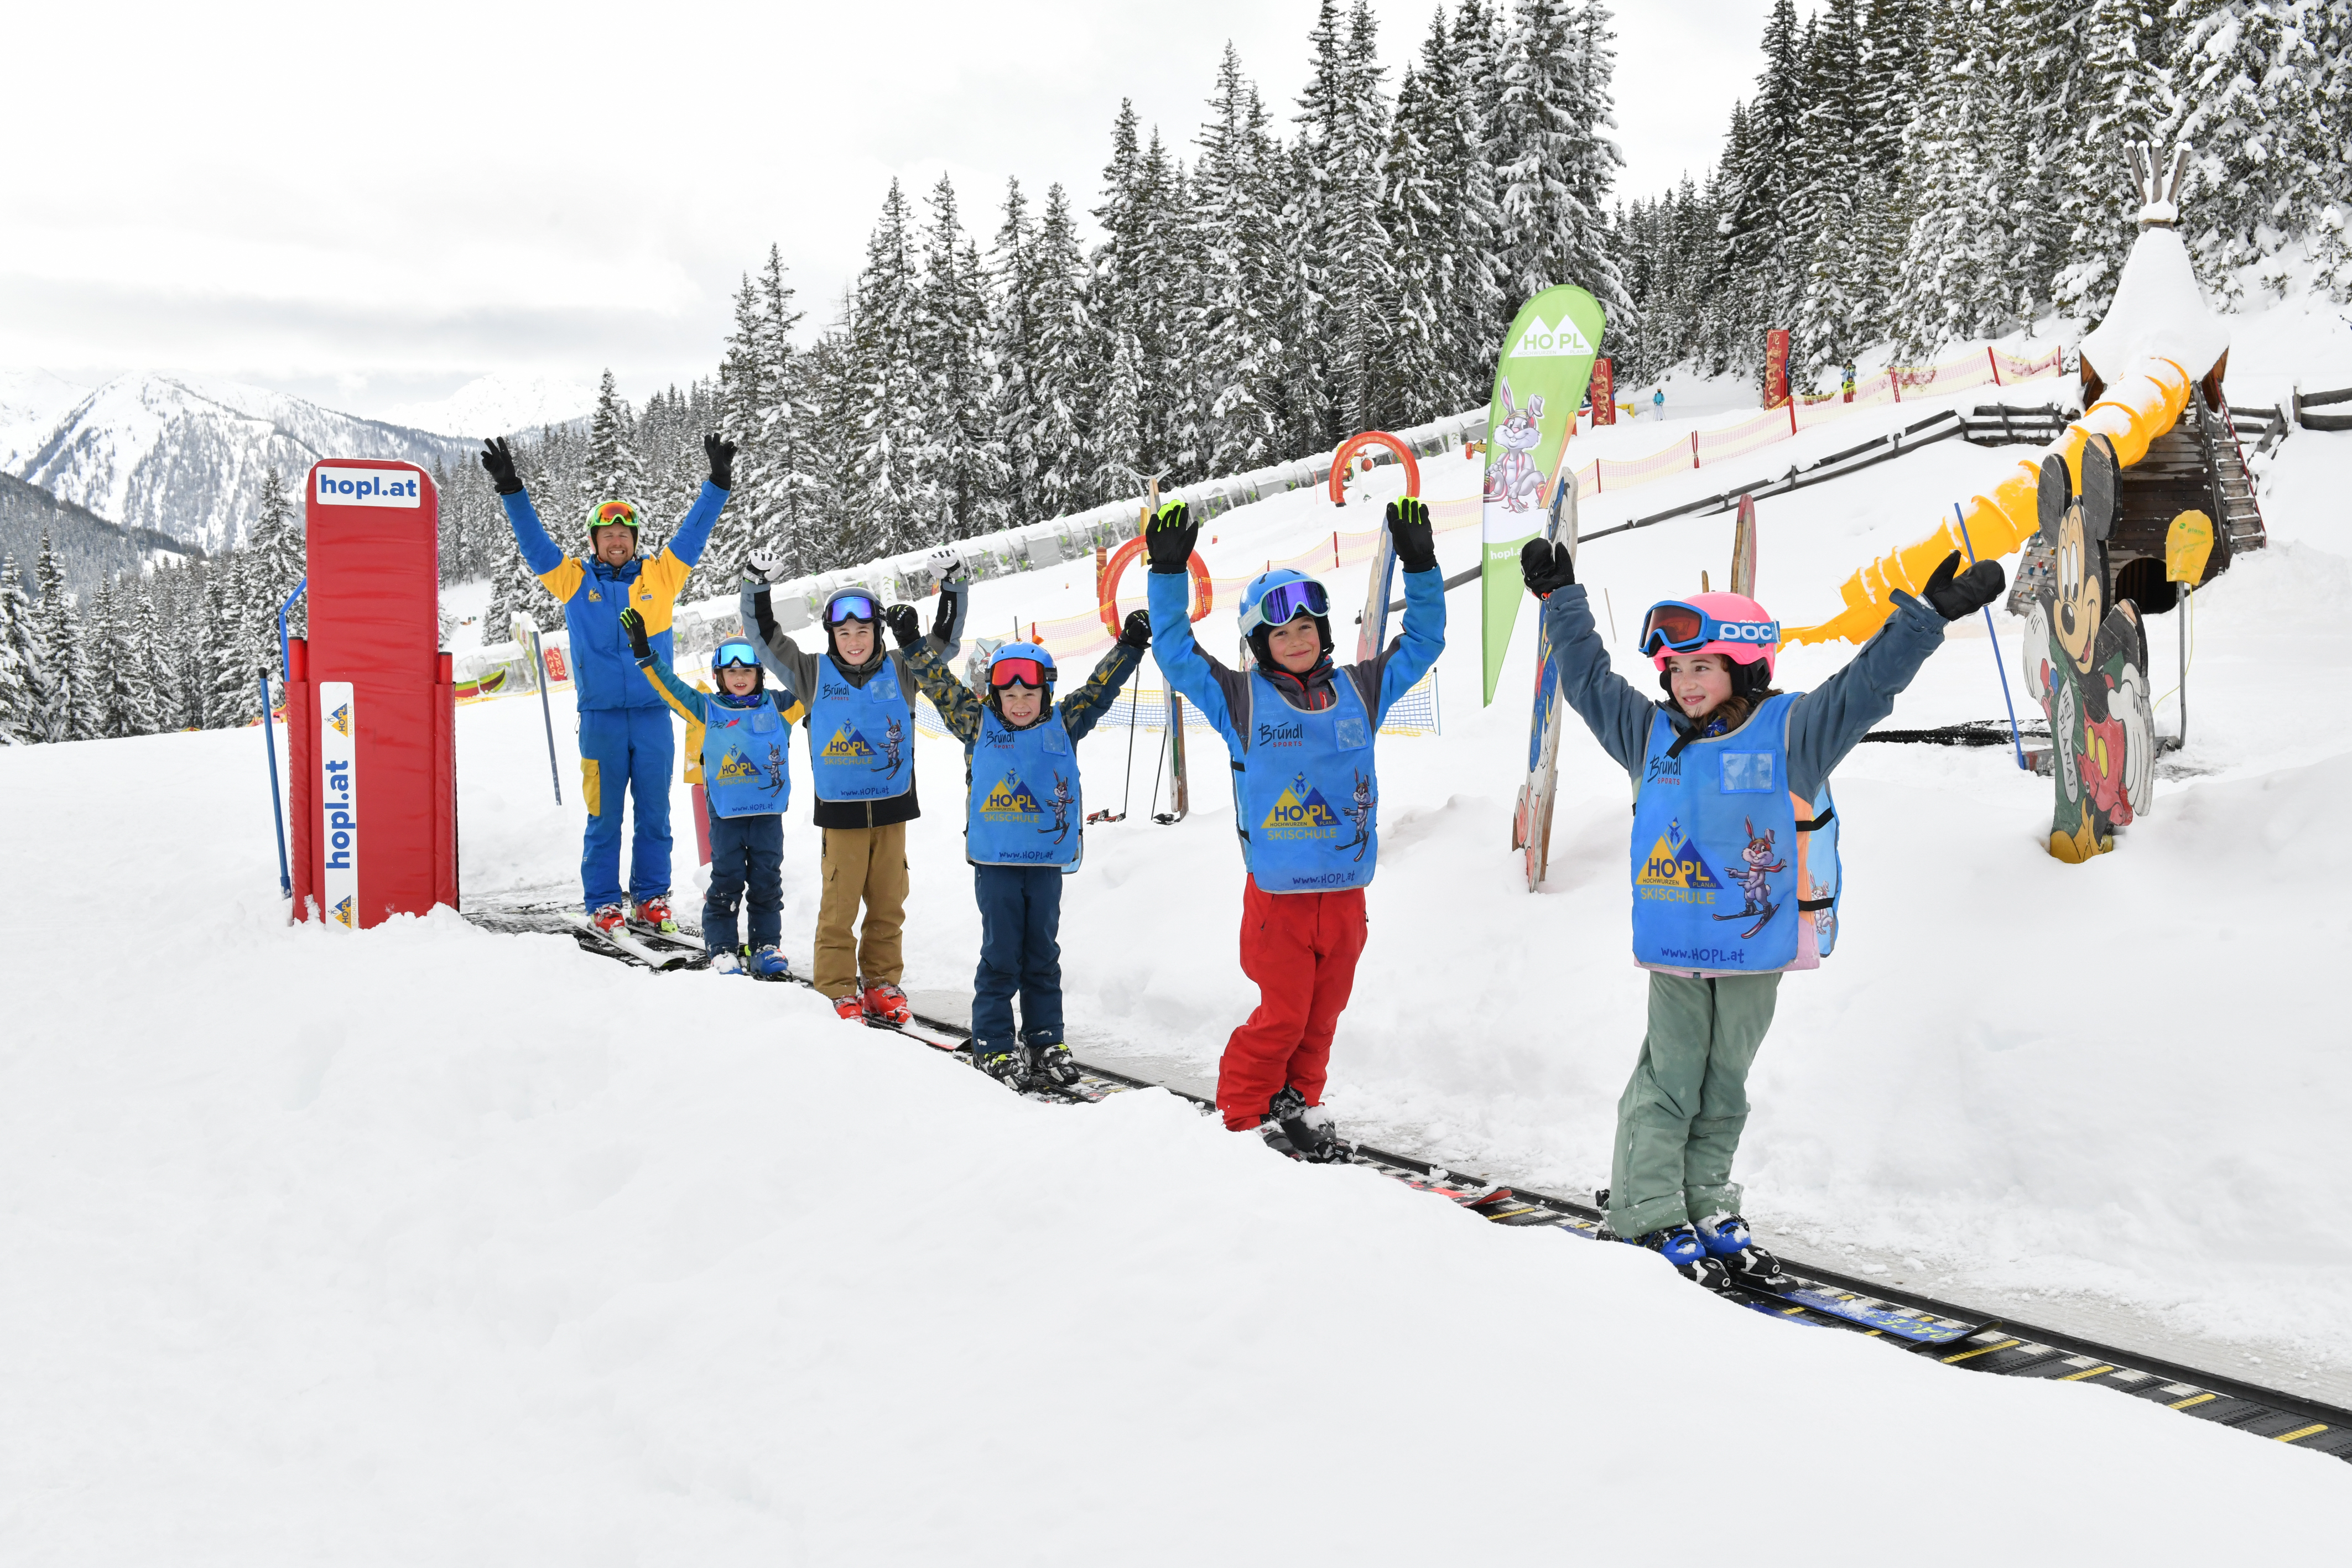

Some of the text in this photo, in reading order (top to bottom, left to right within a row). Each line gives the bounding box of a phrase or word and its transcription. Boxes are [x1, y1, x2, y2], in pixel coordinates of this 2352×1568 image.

[1771, 333, 1780, 345] 龙
[321, 475, 417, 499] hopl.at
[1490, 547, 1522, 560] hopl.a
[824, 757, 873, 765] SKISCHULE
[719, 777, 759, 786] SKISCHULE
[1657, 777, 1680, 785] SPORTS
[840, 785, 889, 796] www.HOPL.at
[732, 802, 774, 812] www.HOPL.at
[325, 760, 356, 869] hopl.at
[984, 813, 1039, 823] SKISCHULE
[1267, 828, 1337, 840] SKISCHULE
[1000, 851, 1053, 859] www.HOPL.at
[1293, 870, 1355, 885] www.HOPL.at
[1641, 888, 1716, 904] SKISCHULE
[1661, 947, 1745, 965] www.HOPL.at
